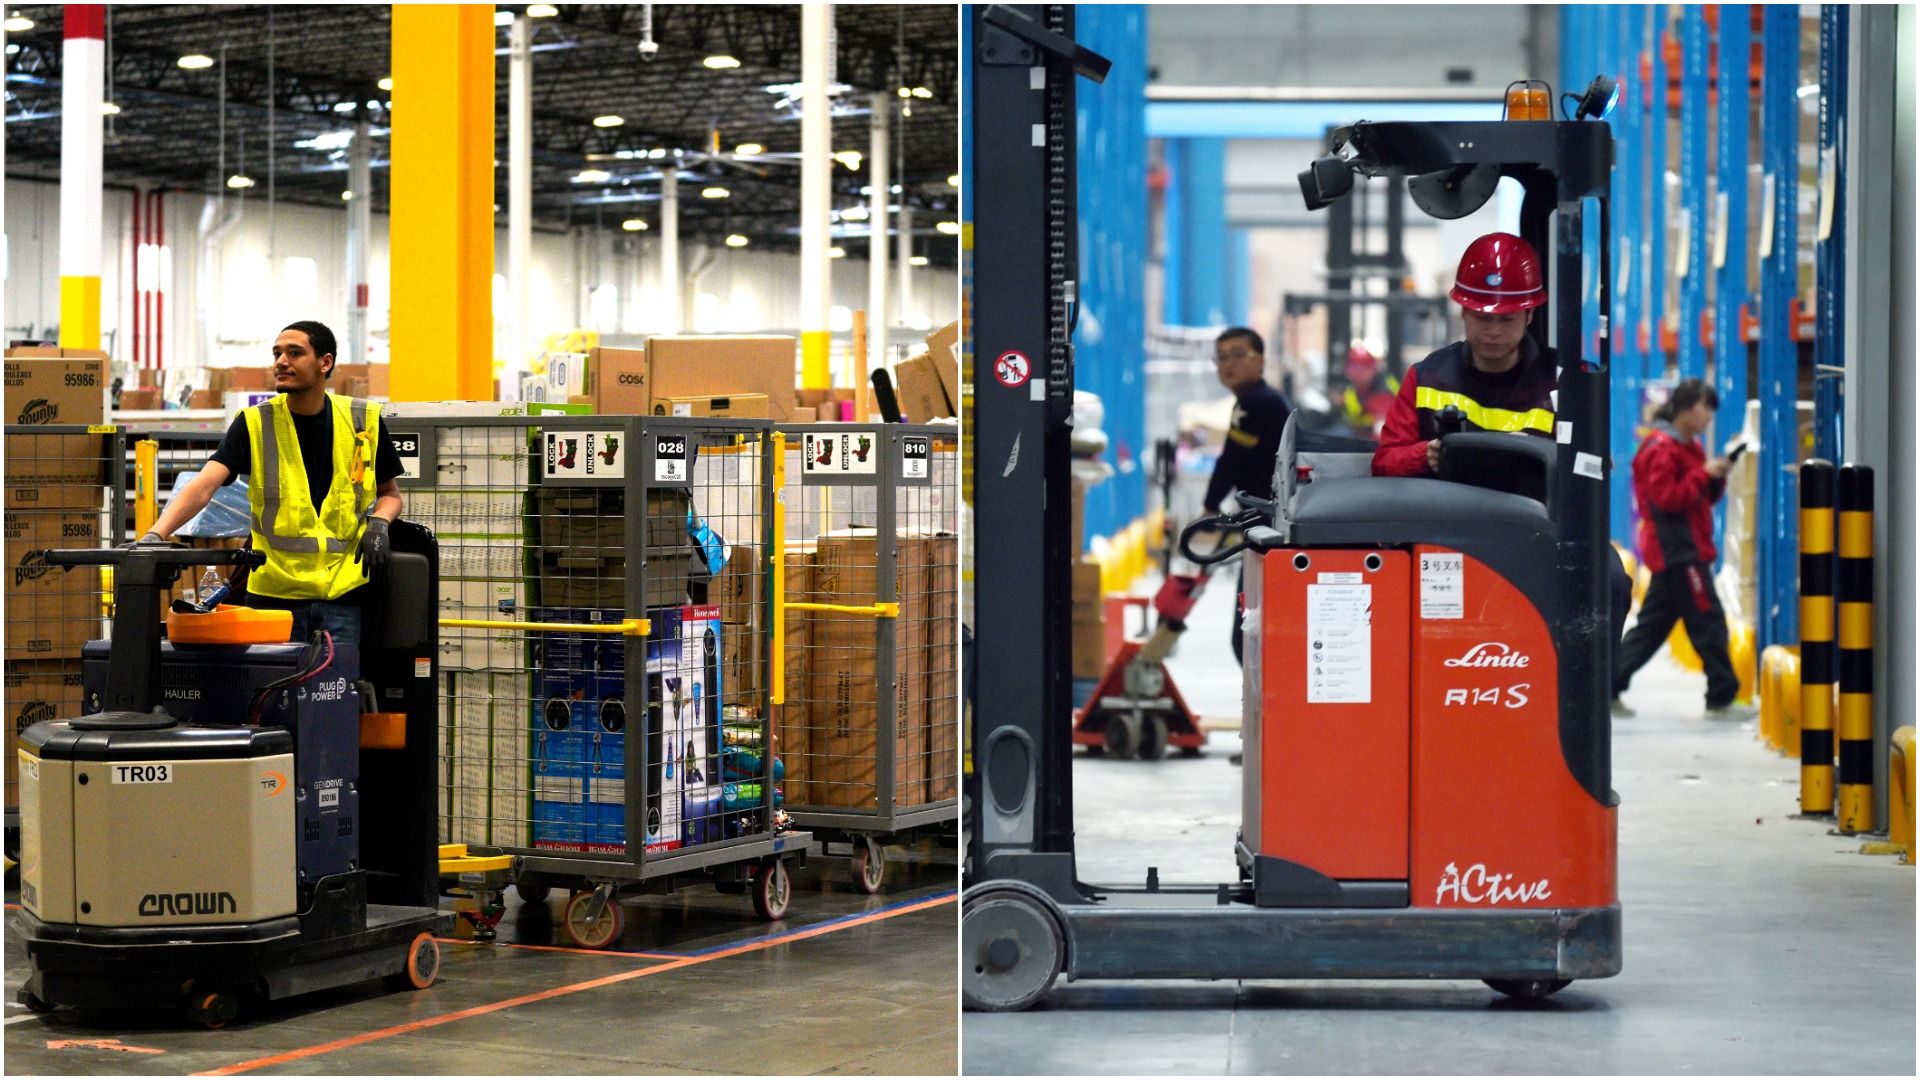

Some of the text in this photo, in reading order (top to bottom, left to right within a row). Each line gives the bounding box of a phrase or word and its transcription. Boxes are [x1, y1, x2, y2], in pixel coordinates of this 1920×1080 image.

[64, 373, 95, 387] 95986
[658, 442, 684, 454] 028
[905, 443, 926, 454] 810
[1443, 642, 1530, 668] Linde
[319, 681, 336, 691] PLUG
[164, 689, 201, 700] HAULER
[311, 691, 336, 701] POWER
[117, 765, 168, 782] TR03
[261, 780, 277, 789] TR
[313, 778, 344, 790] GENDRIVE
[1436, 861, 1552, 905] ACtive
[138, 892, 237, 916] CROWN
